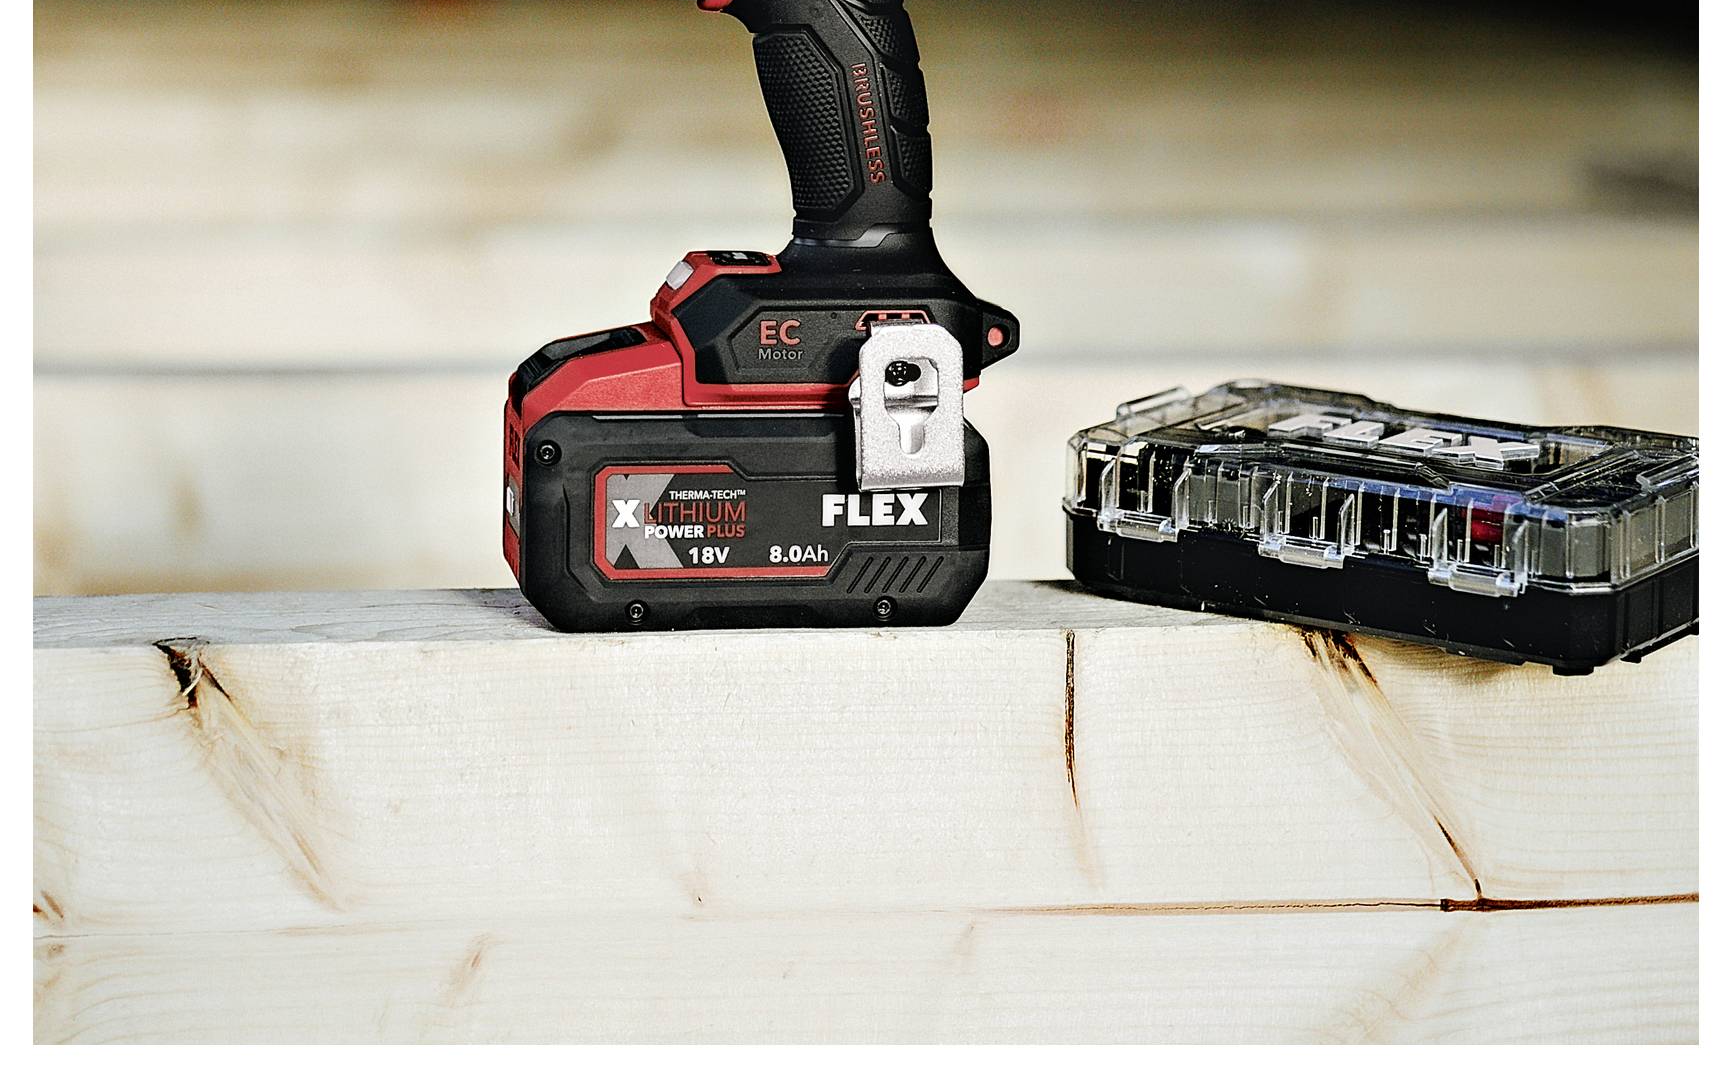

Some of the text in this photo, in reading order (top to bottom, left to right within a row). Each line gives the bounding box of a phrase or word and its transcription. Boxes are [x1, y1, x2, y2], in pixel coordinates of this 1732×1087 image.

[851, 63, 886, 186] BRUSHLESS
[760, 320, 801, 345] EC
[758, 348, 804, 360] Motor
[1267, 413, 1540, 470] FLEX
[822, 493, 928, 527] FLEX
[644, 524, 746, 539] POWER PLUS
[688, 544, 829, 564] 18V 8.0Ah
